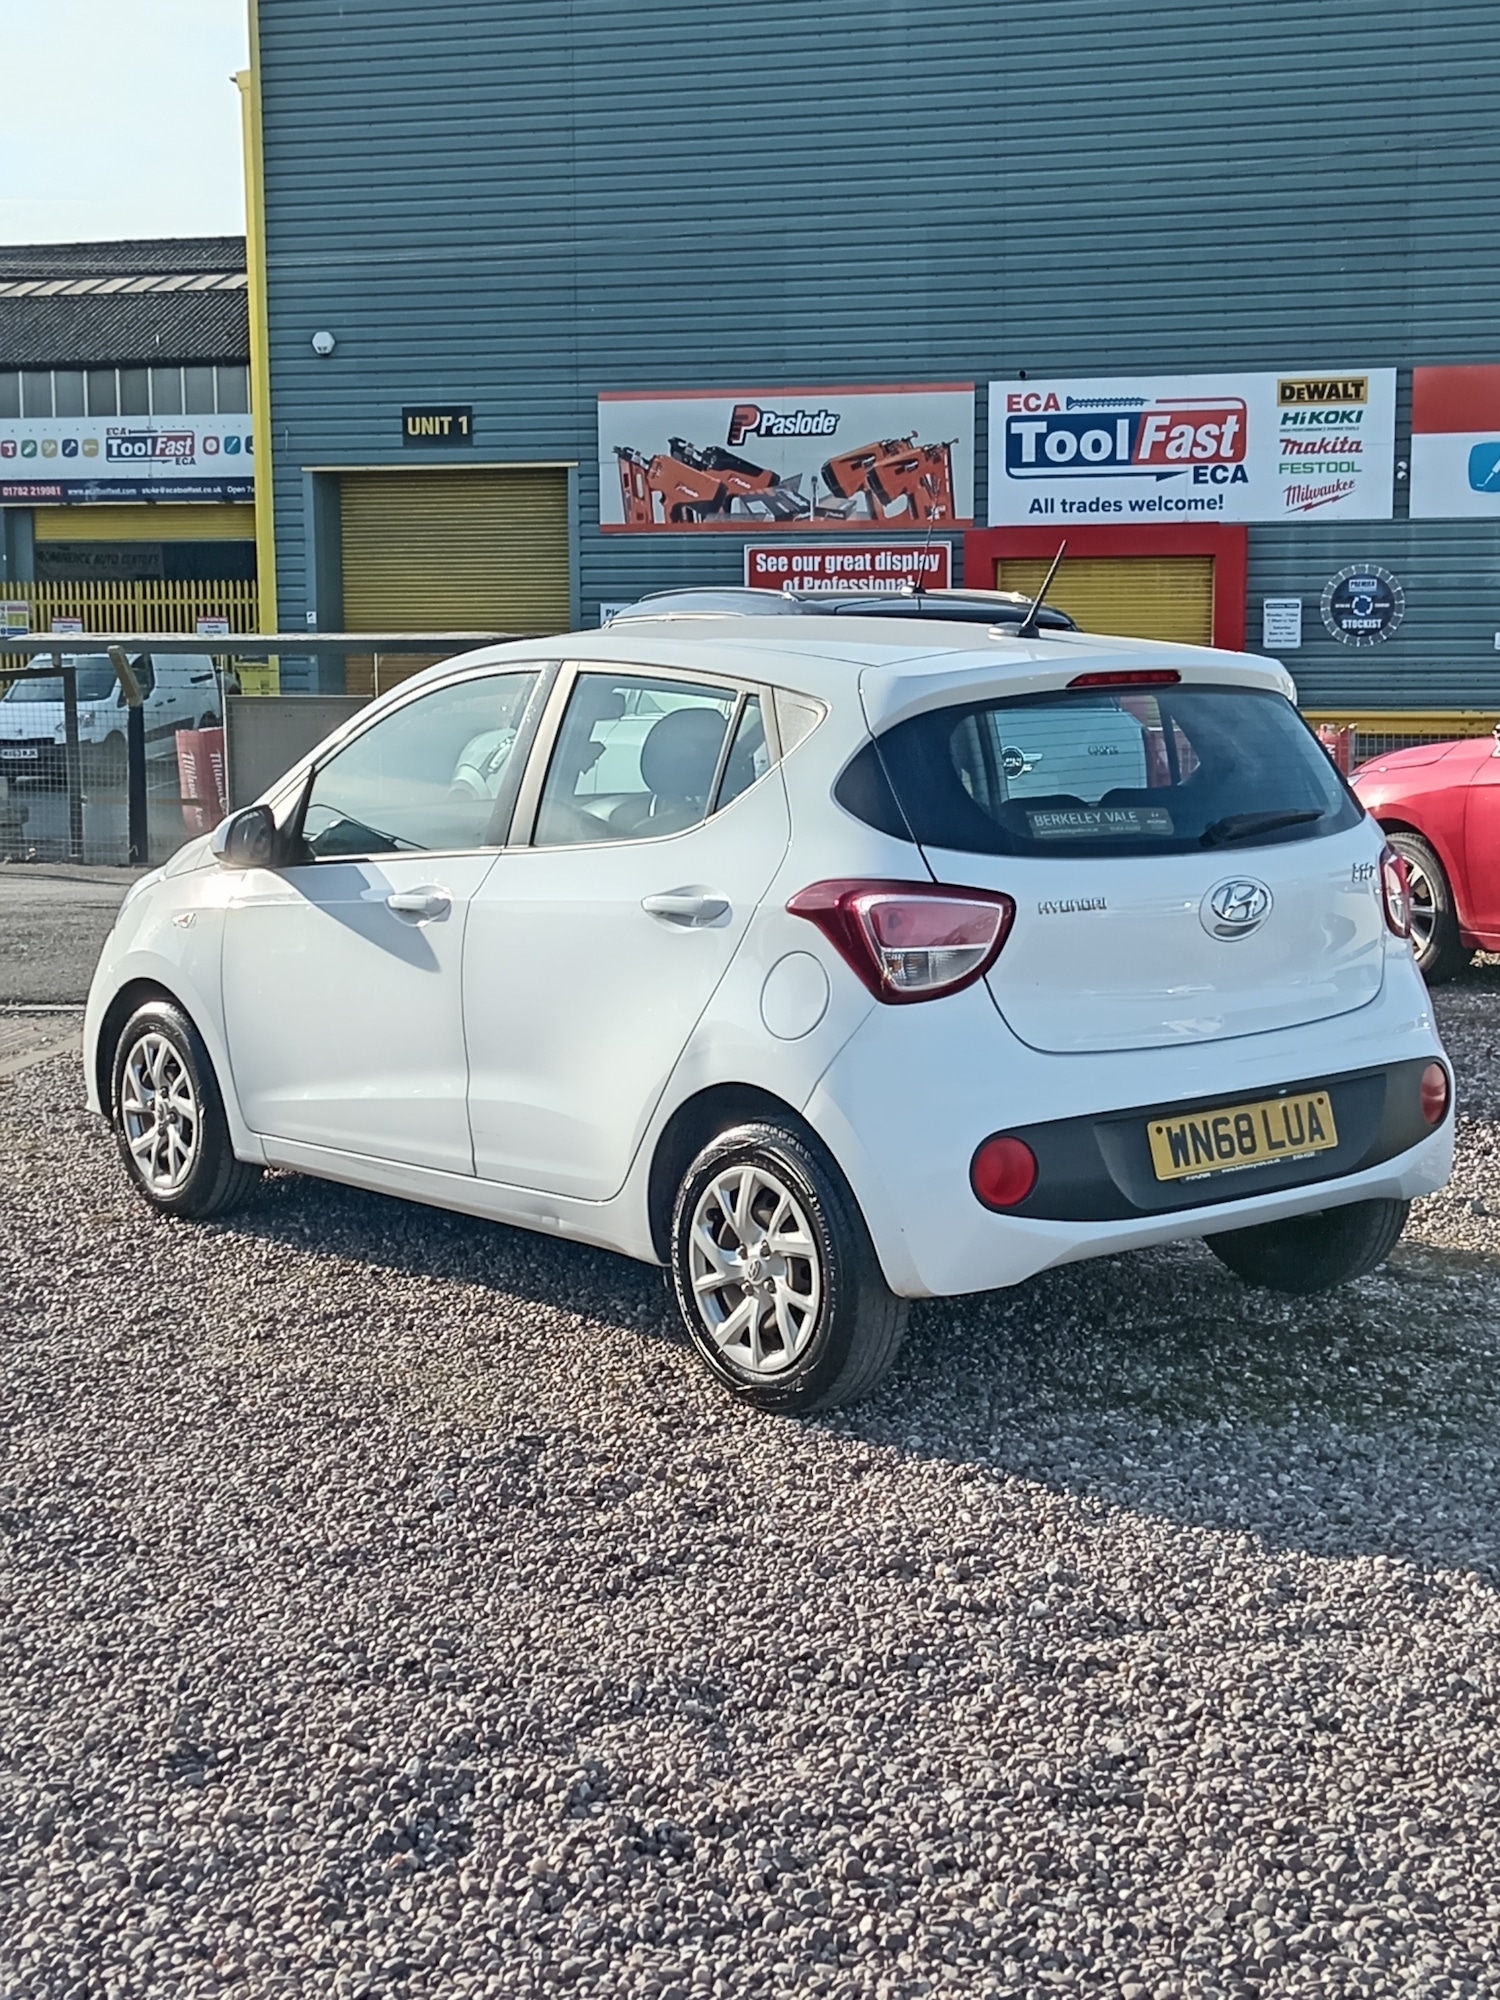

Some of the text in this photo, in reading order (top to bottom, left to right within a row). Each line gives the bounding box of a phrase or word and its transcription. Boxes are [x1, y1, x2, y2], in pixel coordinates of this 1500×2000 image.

[1007, 393, 1061, 412] ECA
[407, 415, 468, 435] UNIT 1
[760, 412, 836, 435] Paslode
[1280, 410, 1364, 425] HiKOKI
[1279, 436, 1363, 455] makita
[175, 457, 196, 465] ECA
[1279, 461, 1362, 474] FESTOOL
[1193, 464, 1249, 484] ECA
[227, 485, 246, 494] Open
[1283, 479, 1356, 506] Milwaukee
[1029, 494, 1225, 514] All trades welcome!
[756, 551, 940, 573] See our great display
[783, 576, 799, 591] of
[1342, 619, 1382, 629] STOCKIST
[1034, 811, 1138, 826] BERKELEY VALE
[1038, 897, 1107, 915] HYUNDAI
[1166, 1101, 1326, 1168] WN68 LUA
